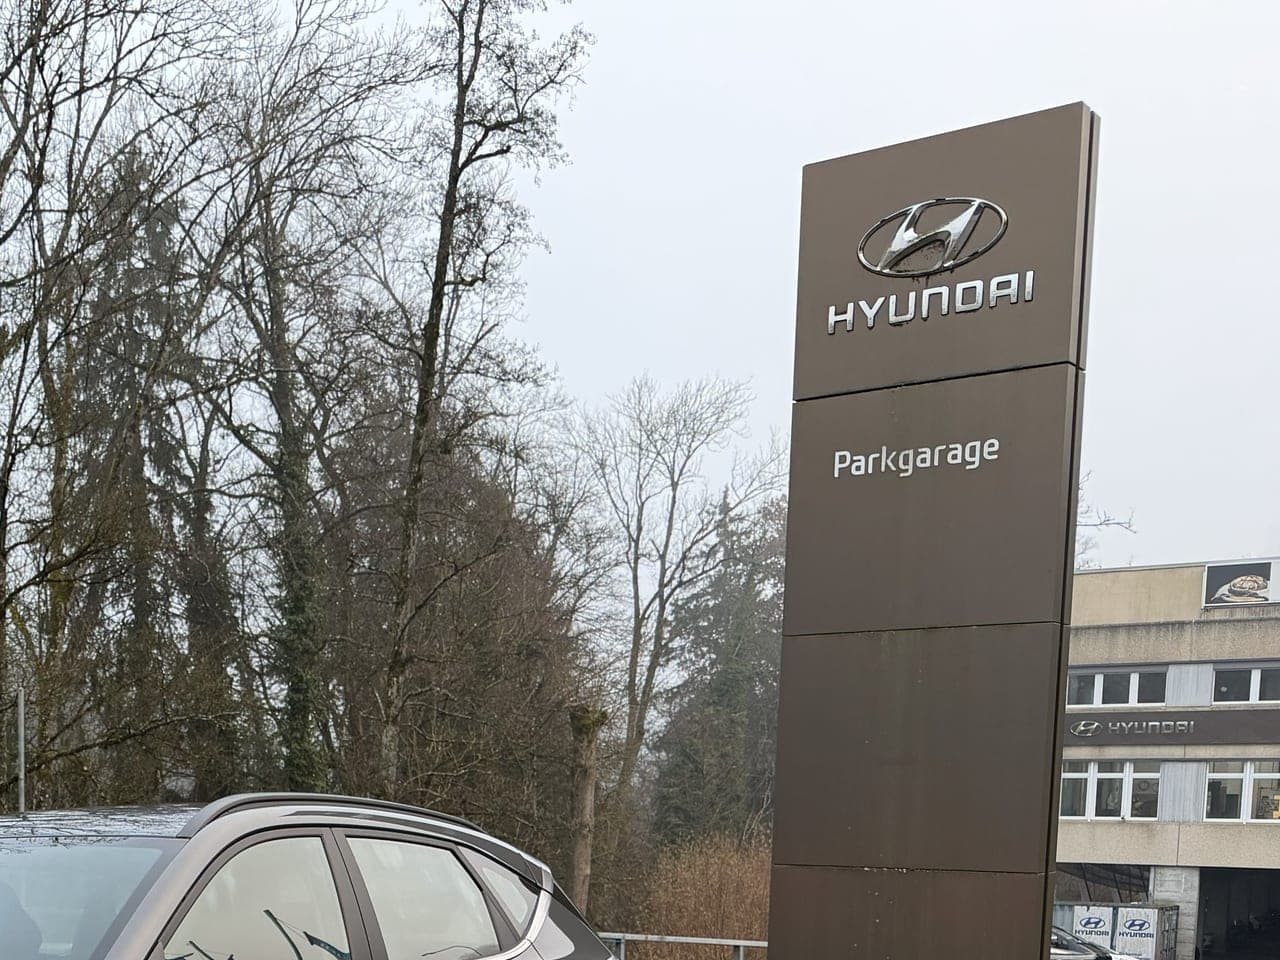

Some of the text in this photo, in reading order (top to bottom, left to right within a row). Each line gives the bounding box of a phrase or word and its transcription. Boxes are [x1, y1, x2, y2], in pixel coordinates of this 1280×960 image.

[826, 270, 1035, 335] HYUNDAI
[833, 438, 1000, 478] Parkgarage
[1107, 720, 1195, 735] HYUNDAI
[1074, 929, 1110, 937] HYUNDAI
[1118, 931, 1155, 939] HYUNDAI
